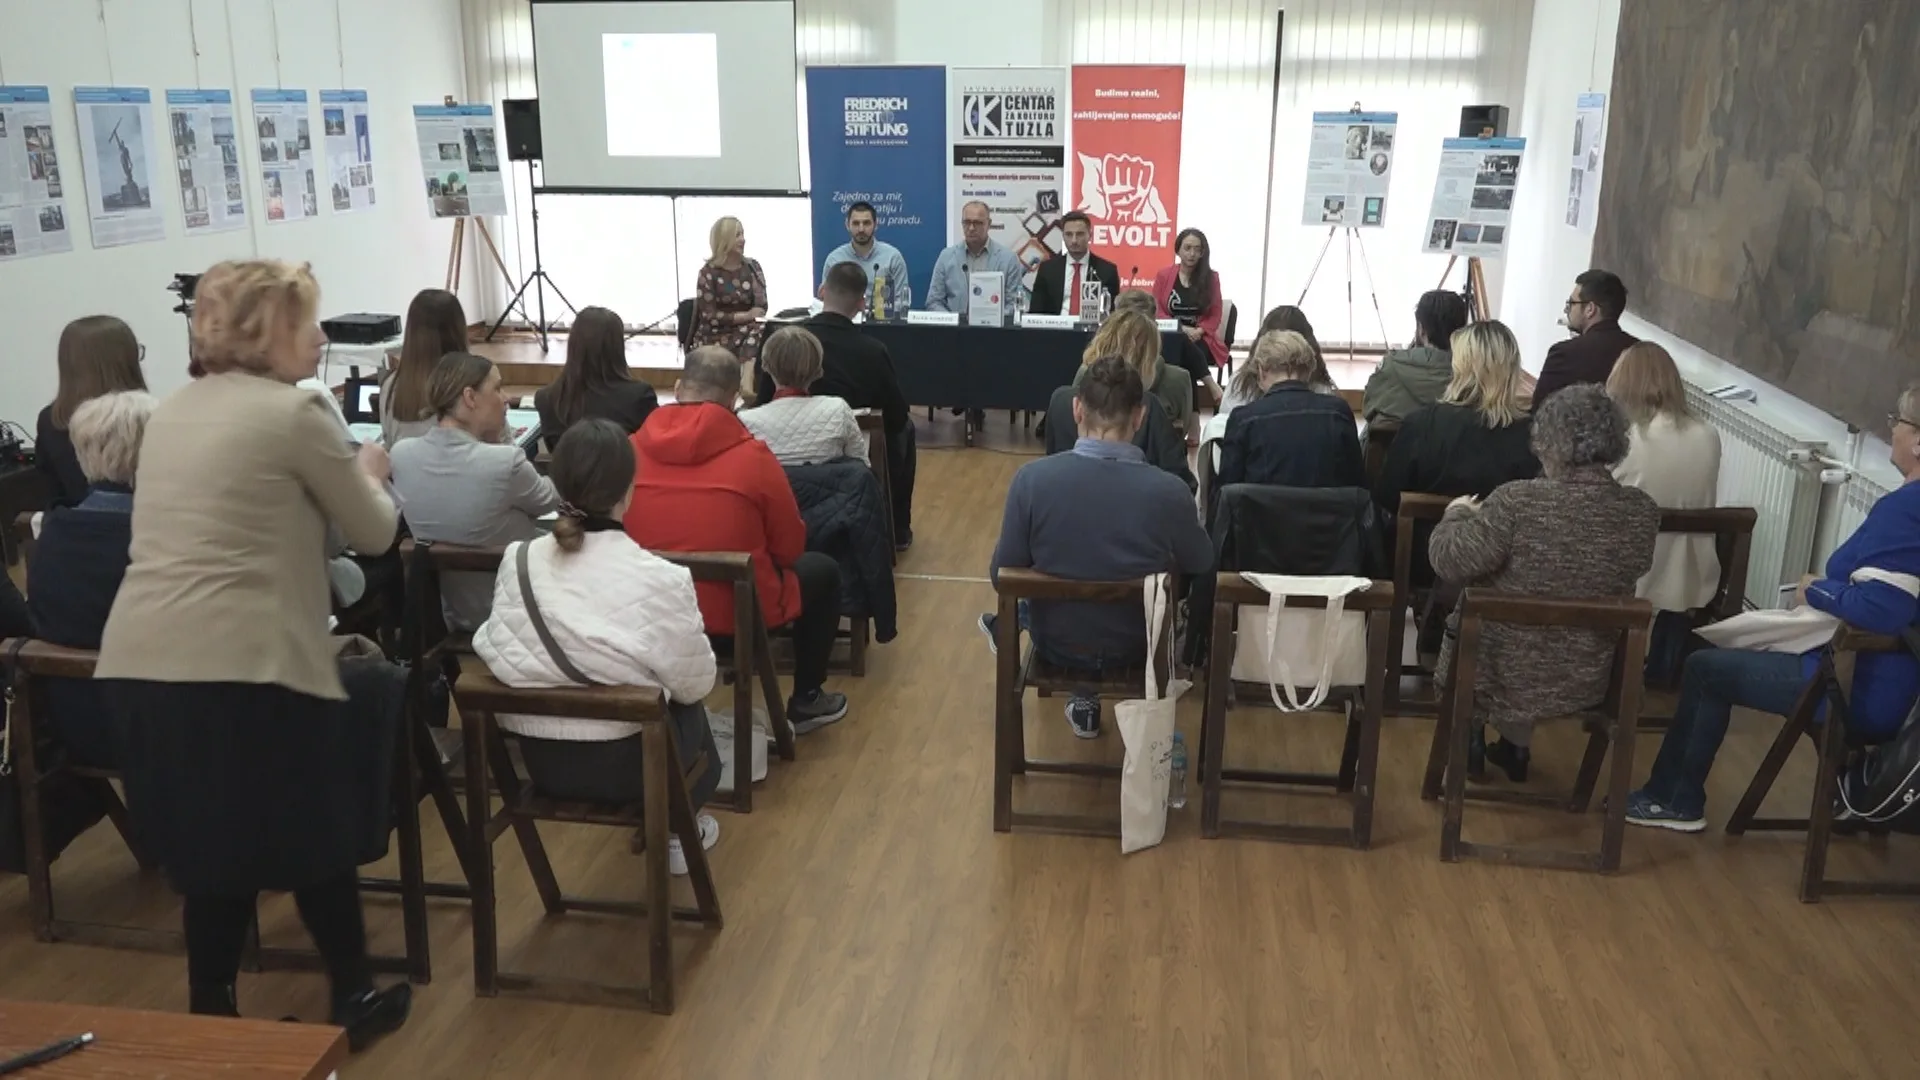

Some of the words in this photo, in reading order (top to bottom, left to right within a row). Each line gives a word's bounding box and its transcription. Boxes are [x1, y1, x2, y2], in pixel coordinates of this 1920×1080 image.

[1095, 89, 1129, 97] Budimo
[1131, 89, 1160, 98] realni,
[844, 97, 908, 110] FRIEDRICH
[1005, 95, 1055, 110] CENTAR
[844, 111, 881, 122] EBERT
[1005, 112, 1015, 120] ZA
[1017, 112, 1055, 120] KULTURU
[845, 123, 909, 136] STIFTUNG
[1005, 121, 1054, 136] TUZLA
[832, 191, 870, 203] Zajedno
[885, 192, 903, 202] mir,
[1088, 225, 1171, 247] EVOLT
